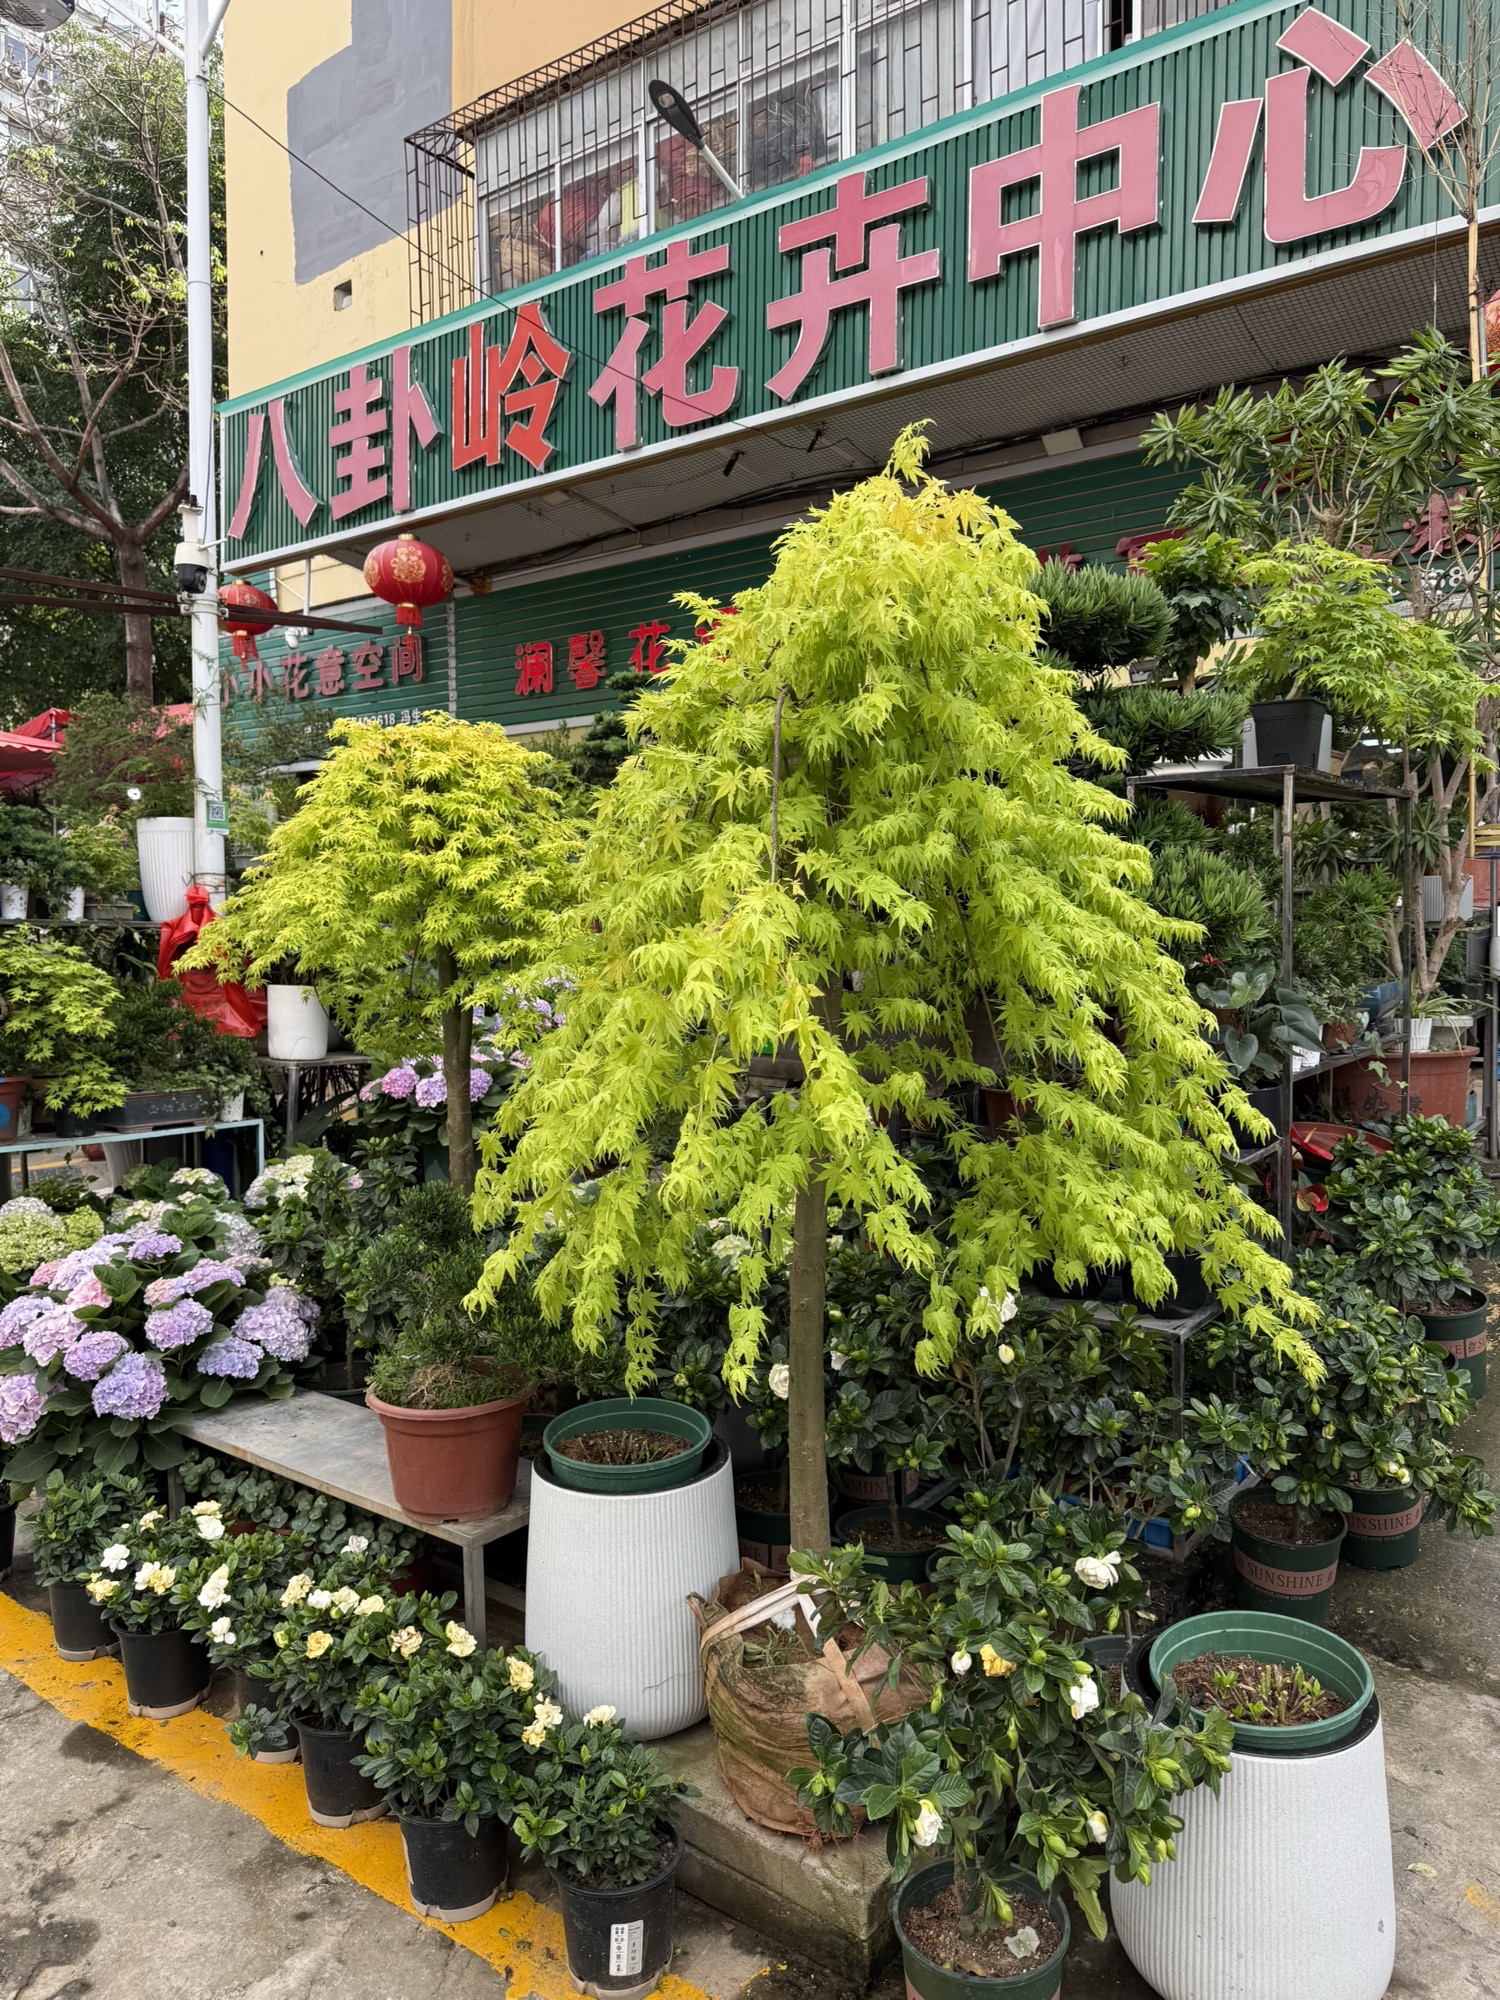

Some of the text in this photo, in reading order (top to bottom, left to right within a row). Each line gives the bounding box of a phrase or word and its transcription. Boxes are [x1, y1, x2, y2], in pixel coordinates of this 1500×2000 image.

[228, 6, 1466, 539] 八卦岭花卉中心
[514, 607, 738, 697] 澜馨花
[1346, 1513, 1412, 1531] UNSHINE
[1247, 1562, 1324, 1589] SUNSHINE
